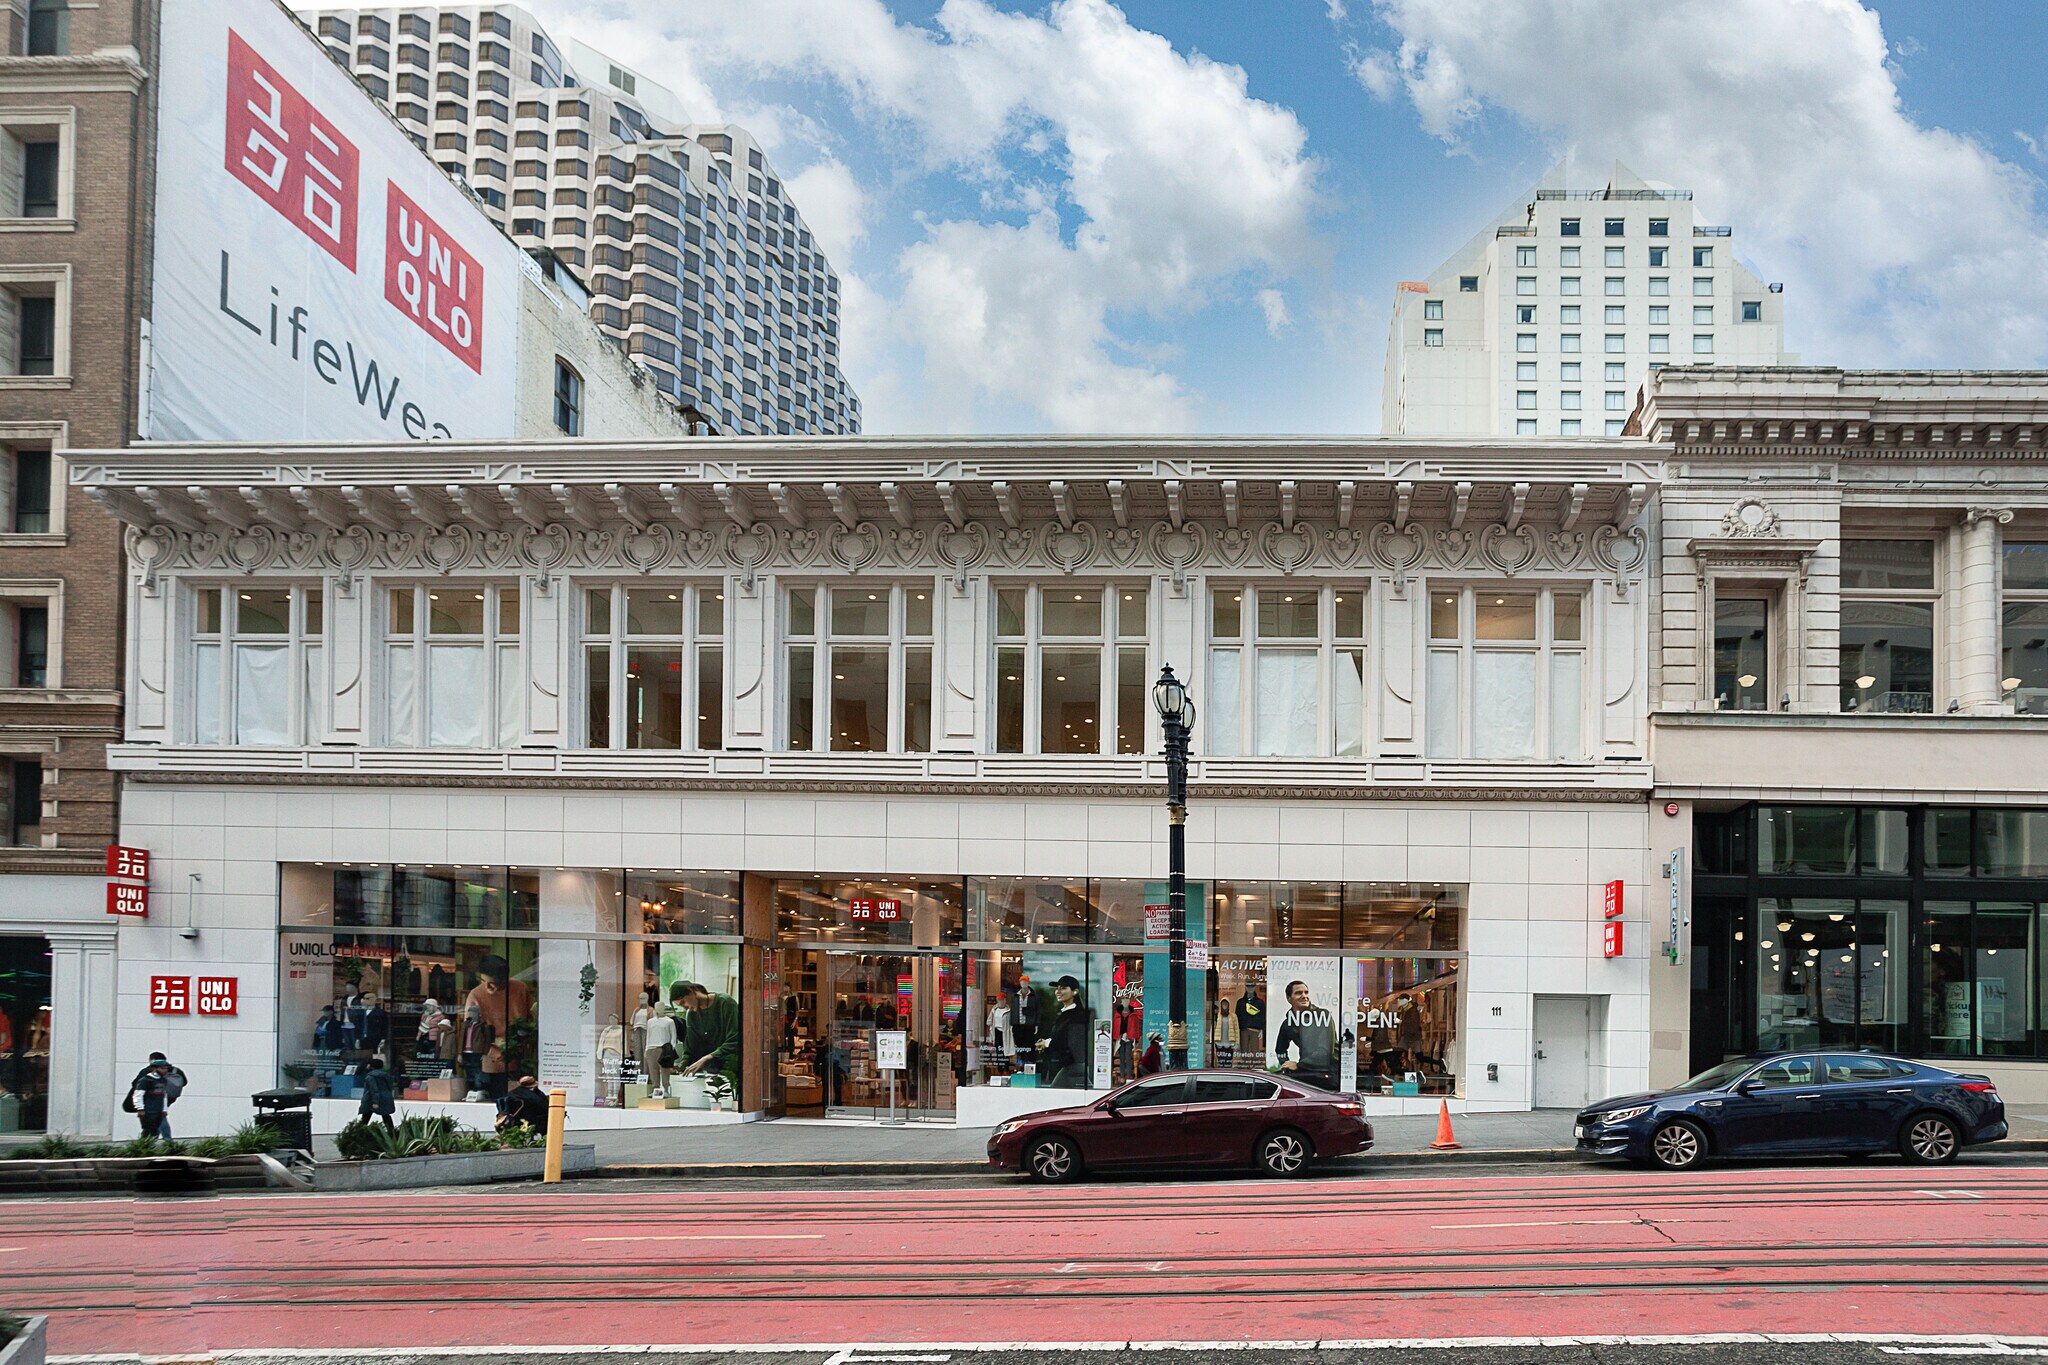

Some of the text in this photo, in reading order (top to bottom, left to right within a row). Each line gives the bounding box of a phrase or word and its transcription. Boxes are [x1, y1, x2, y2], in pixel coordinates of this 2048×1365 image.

[399, 206, 468, 301] UNI
[397, 260, 473, 349] QLO
[117, 887, 143, 900] UNI
[116, 900, 145, 912] QLO
[878, 901, 896, 910] UNI
[878, 910, 897, 919] QLO
[1145, 910, 1156, 918] NO
[289, 942, 338, 957] UNIQLO
[1271, 960, 1301, 971] YOUR
[1306, 960, 1336, 972] WAY.
[201, 981, 230, 995] UNI
[200, 996, 232, 1013] QLO
[1316, 993, 1371, 1007] We are
[1491, 1006, 1502, 1016] 111
[1287, 1010, 1398, 1028] NOW OPEN!
[624, 1058, 640, 1066] Crew
